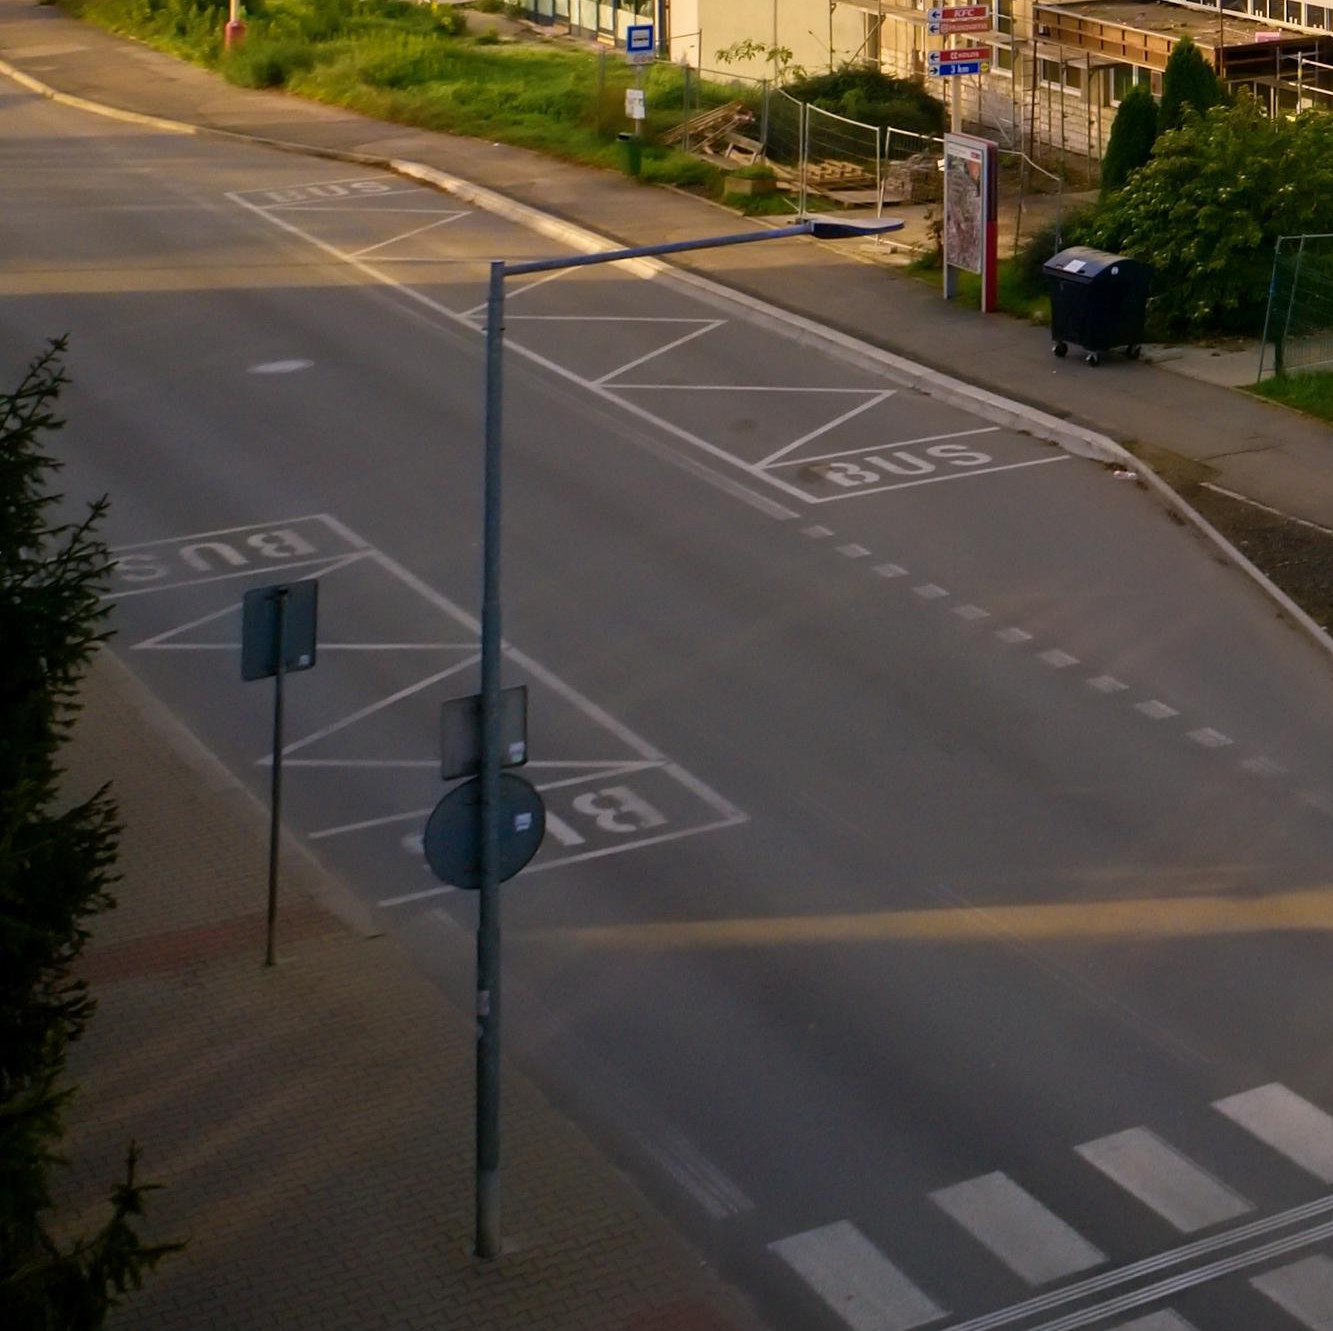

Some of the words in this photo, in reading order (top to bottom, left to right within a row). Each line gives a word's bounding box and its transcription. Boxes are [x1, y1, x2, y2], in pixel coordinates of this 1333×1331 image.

[953, 8, 975, 18] KFC
[950, 64, 956, 74] 3
[957, 64, 970, 73] km
[265, 181, 391, 203] BUS
[821, 444, 993, 487] BUS
[108, 529, 317, 582] BUS
